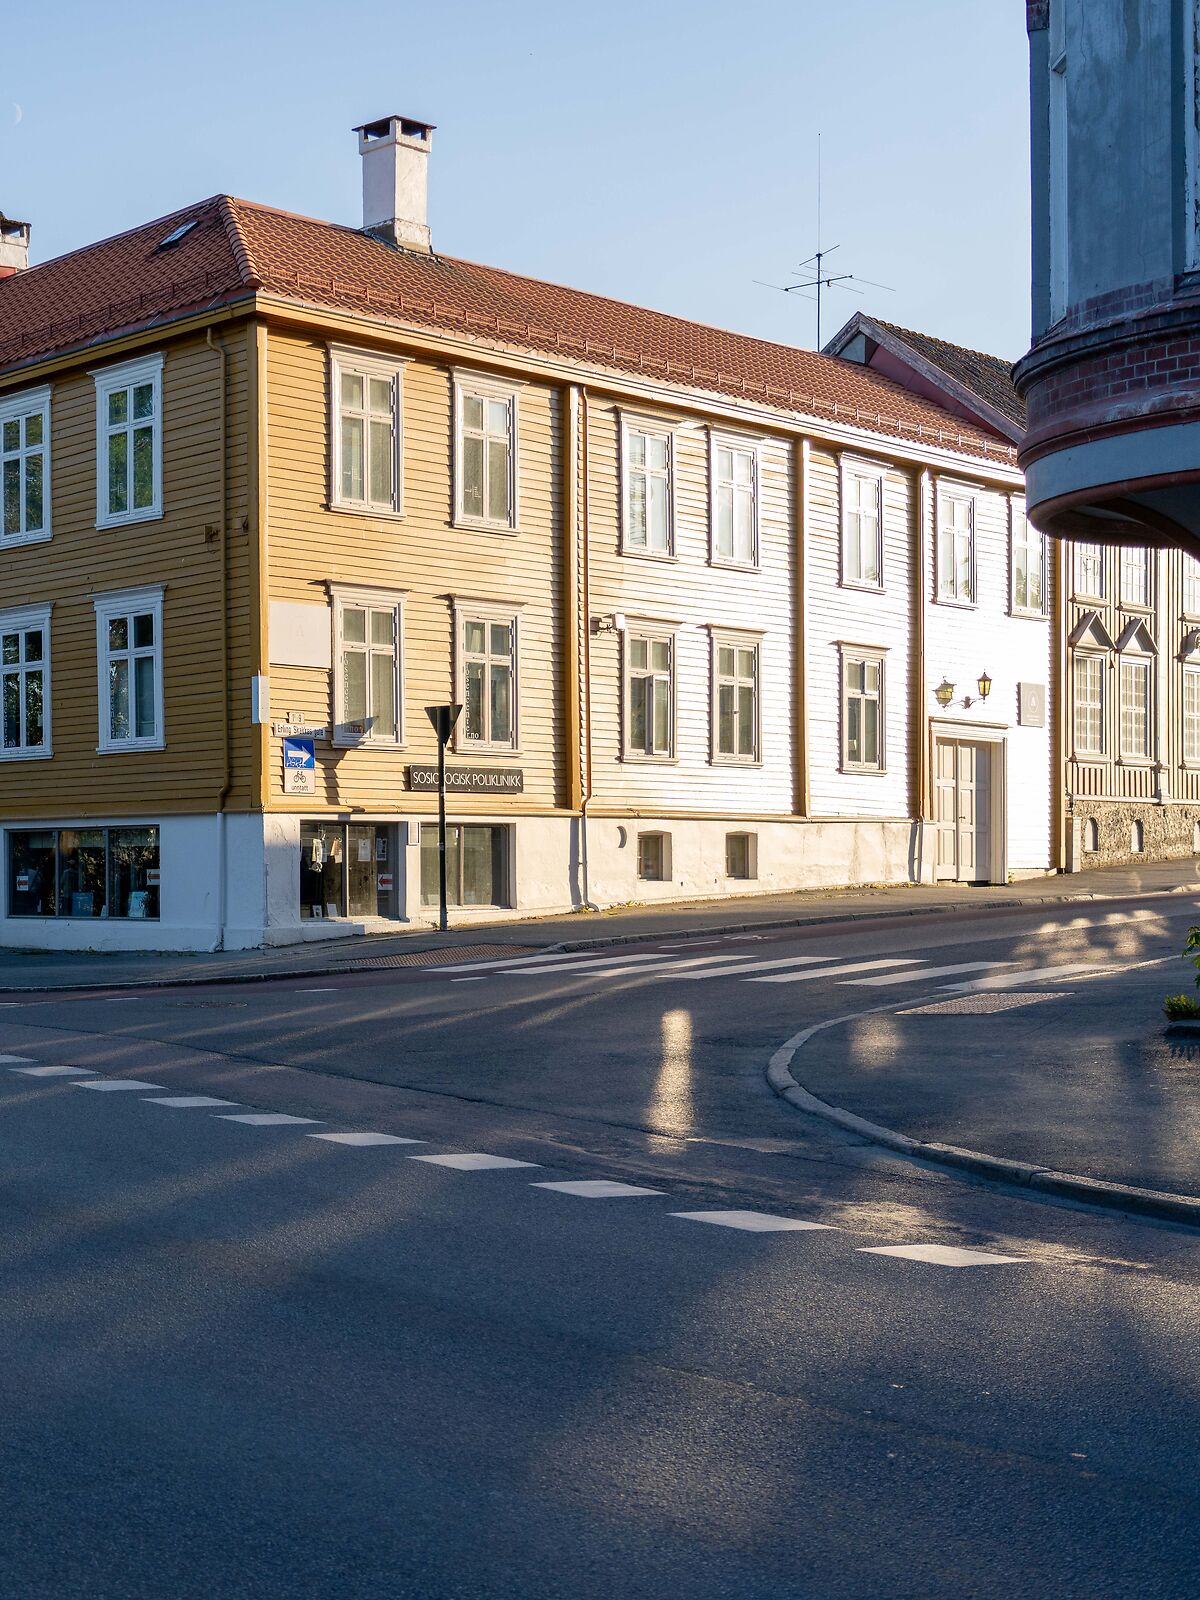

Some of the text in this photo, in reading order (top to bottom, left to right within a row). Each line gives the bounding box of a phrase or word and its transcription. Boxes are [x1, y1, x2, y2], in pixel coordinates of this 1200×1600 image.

[277, 724, 292, 736] Erling
[412, 771, 521, 787] SOSIOOGISK POLIKLINIKK
